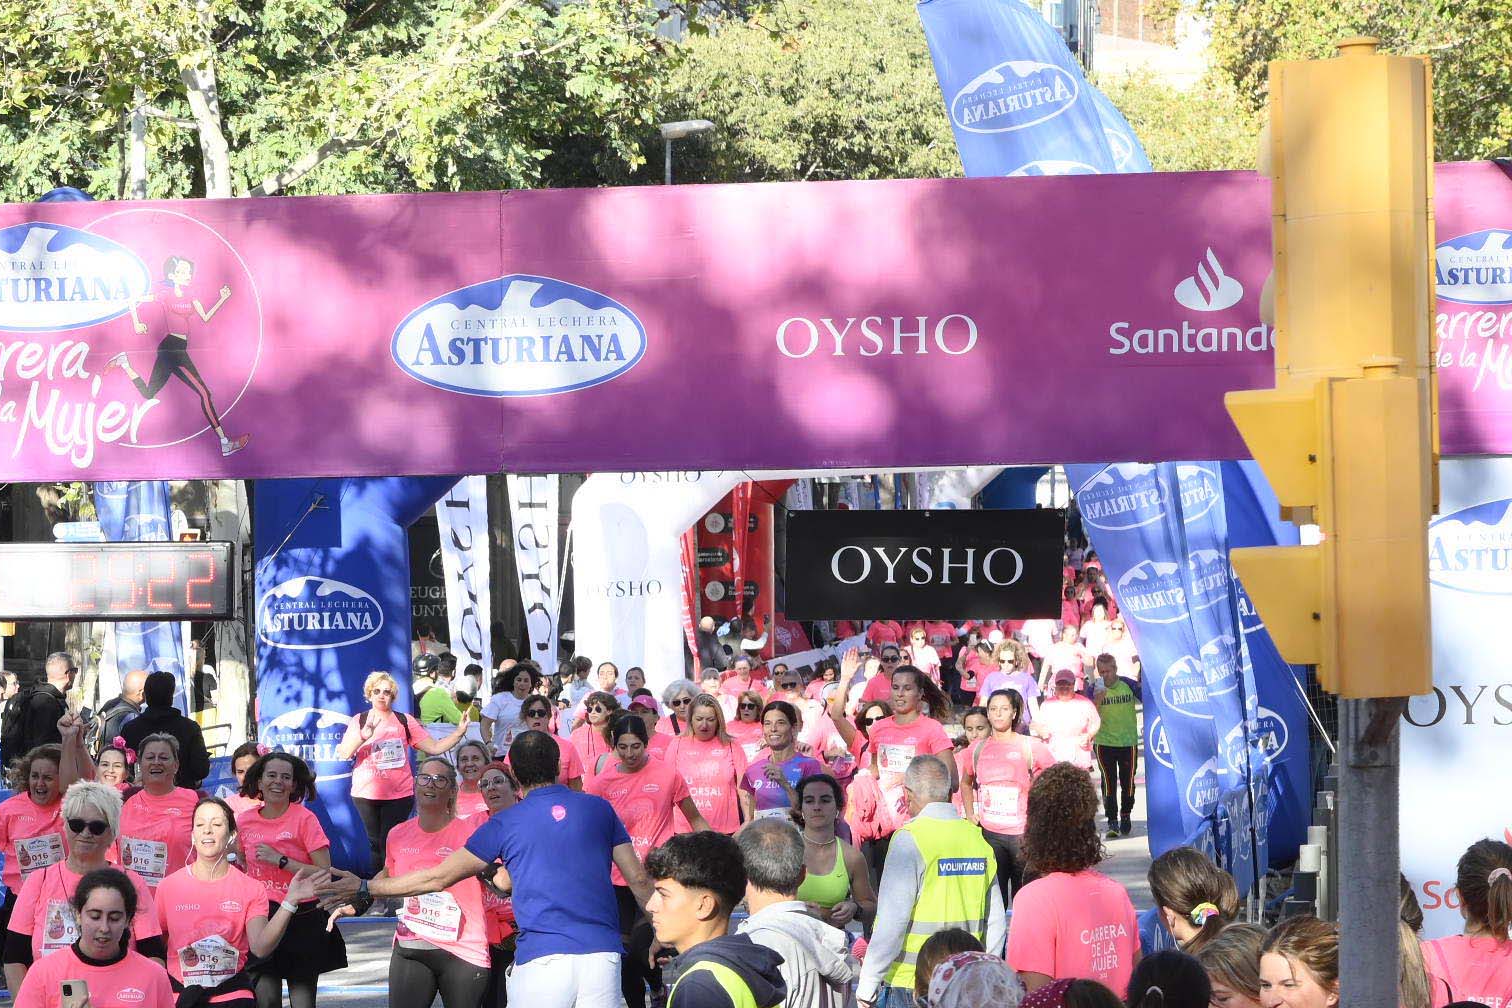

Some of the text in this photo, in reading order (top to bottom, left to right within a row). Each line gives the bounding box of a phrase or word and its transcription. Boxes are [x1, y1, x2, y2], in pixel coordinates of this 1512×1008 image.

[450, 315, 619, 331] CENTRAL LECHERA
[412, 321, 626, 367] ASTURIANA
[775, 314, 979, 359] OYSHO
[10, 370, 161, 468] Mujer
[830, 545, 1024, 588] OYSHO
[274, 600, 370, 611] CENTRAL LECHERA
[262, 606, 374, 633] ASTURIANA
[1401, 683, 1512, 728] OYS
[690, 786, 723, 798] ORSAL
[938, 862, 985, 872] VOLUNTARIS
[1080, 923, 1128, 945] CARRERA
[1092, 940, 1116, 958] DE LA
[1092, 954, 1118, 973] MUJER
